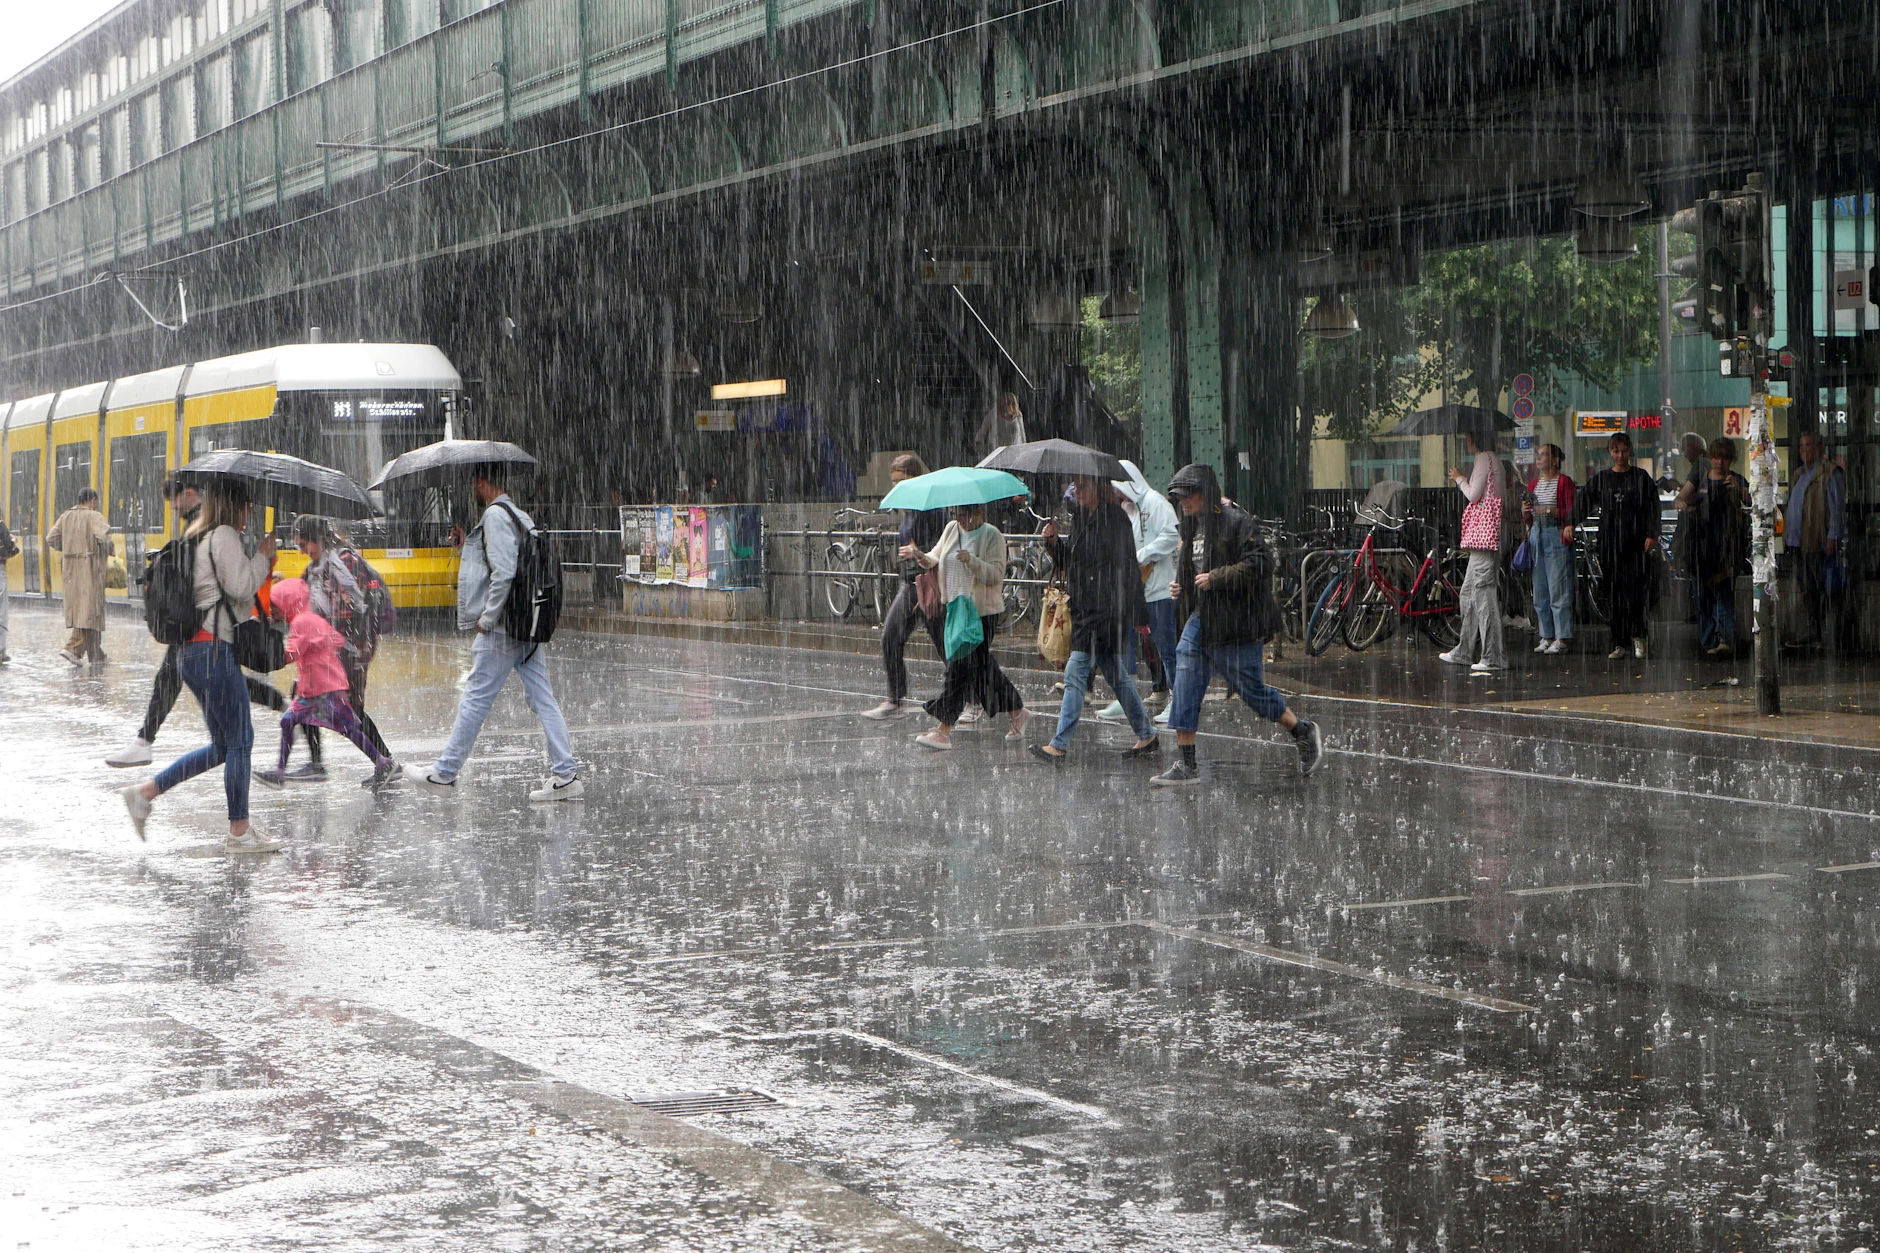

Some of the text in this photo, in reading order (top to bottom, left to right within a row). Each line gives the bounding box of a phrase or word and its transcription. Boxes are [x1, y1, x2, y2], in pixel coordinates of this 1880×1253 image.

[1849, 282, 1862, 295] U2
[1629, 416, 1662, 429] APOTHE
[1818, 410, 1847, 424] NOR
